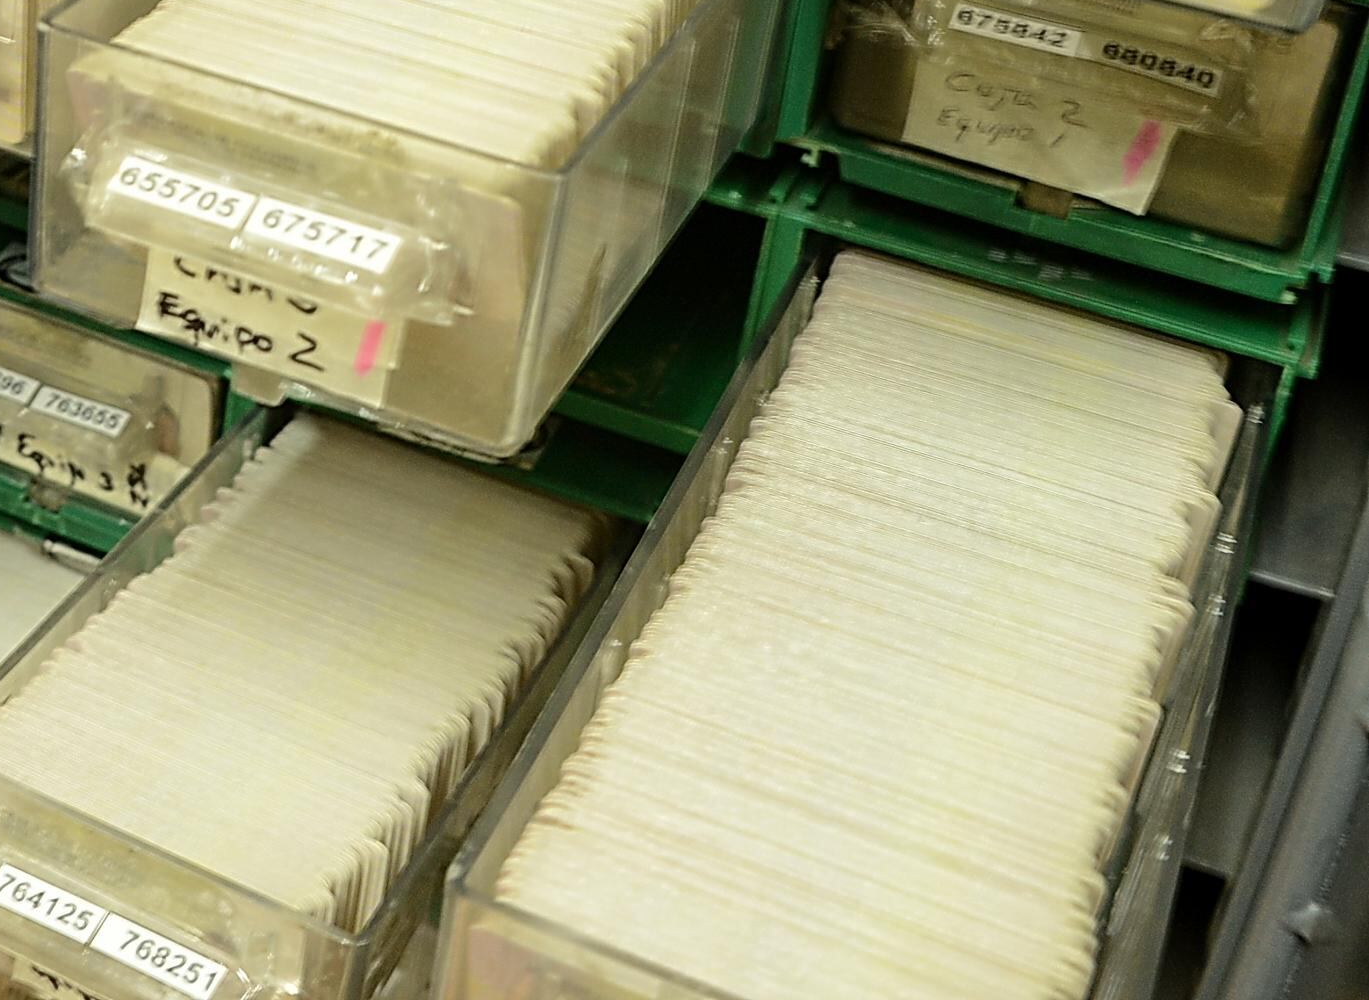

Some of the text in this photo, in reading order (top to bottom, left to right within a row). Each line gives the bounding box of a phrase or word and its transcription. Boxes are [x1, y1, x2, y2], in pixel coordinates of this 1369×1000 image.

[1058, 98, 1091, 131] 2
[119, 165, 392, 263] 655705 675717
[157, 290, 274, 354] Equipo
[288, 331, 326, 373] 2
[43, 392, 122, 428] 763655
[118, 929, 220, 993] 768251
